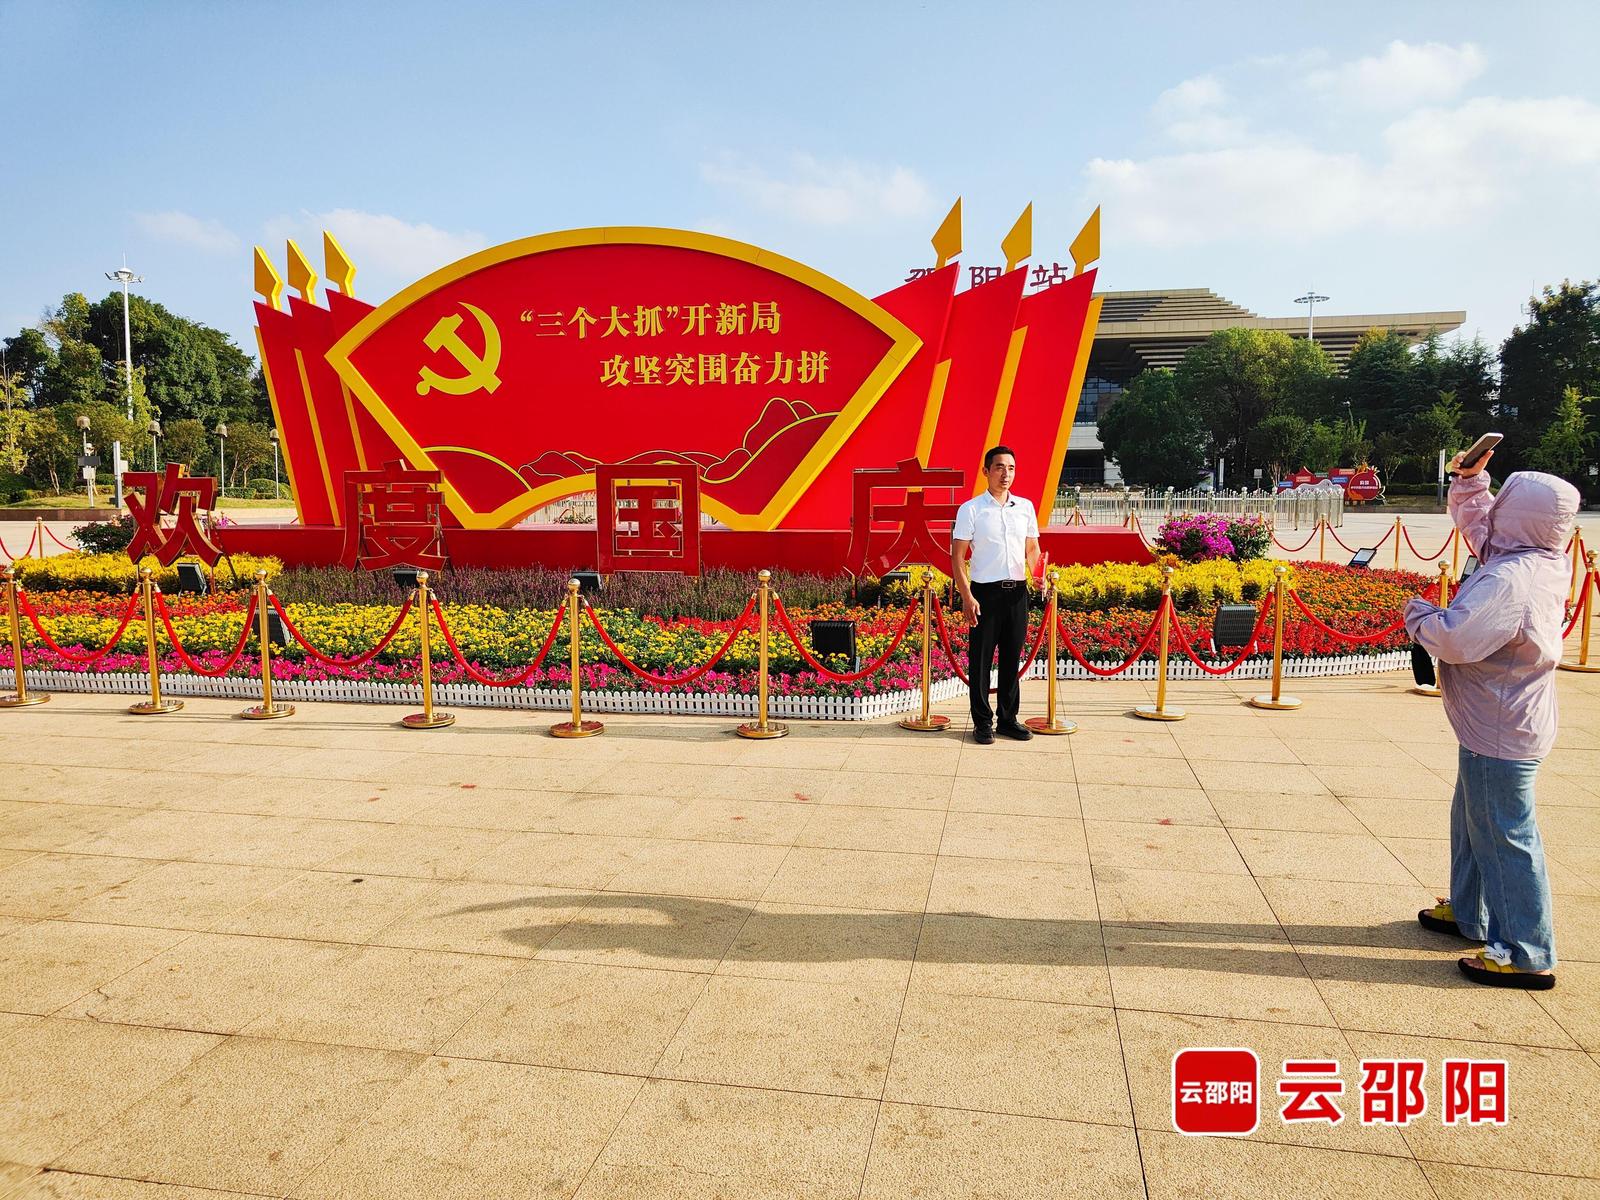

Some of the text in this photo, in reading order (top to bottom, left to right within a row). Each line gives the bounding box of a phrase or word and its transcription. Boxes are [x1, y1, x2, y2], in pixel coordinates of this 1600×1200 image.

[520, 301, 781, 339] “三个大抓”开新局
[600, 350, 830, 387] 攻坚突围奋力拼
[123, 457, 965, 578] 欢度国庆
